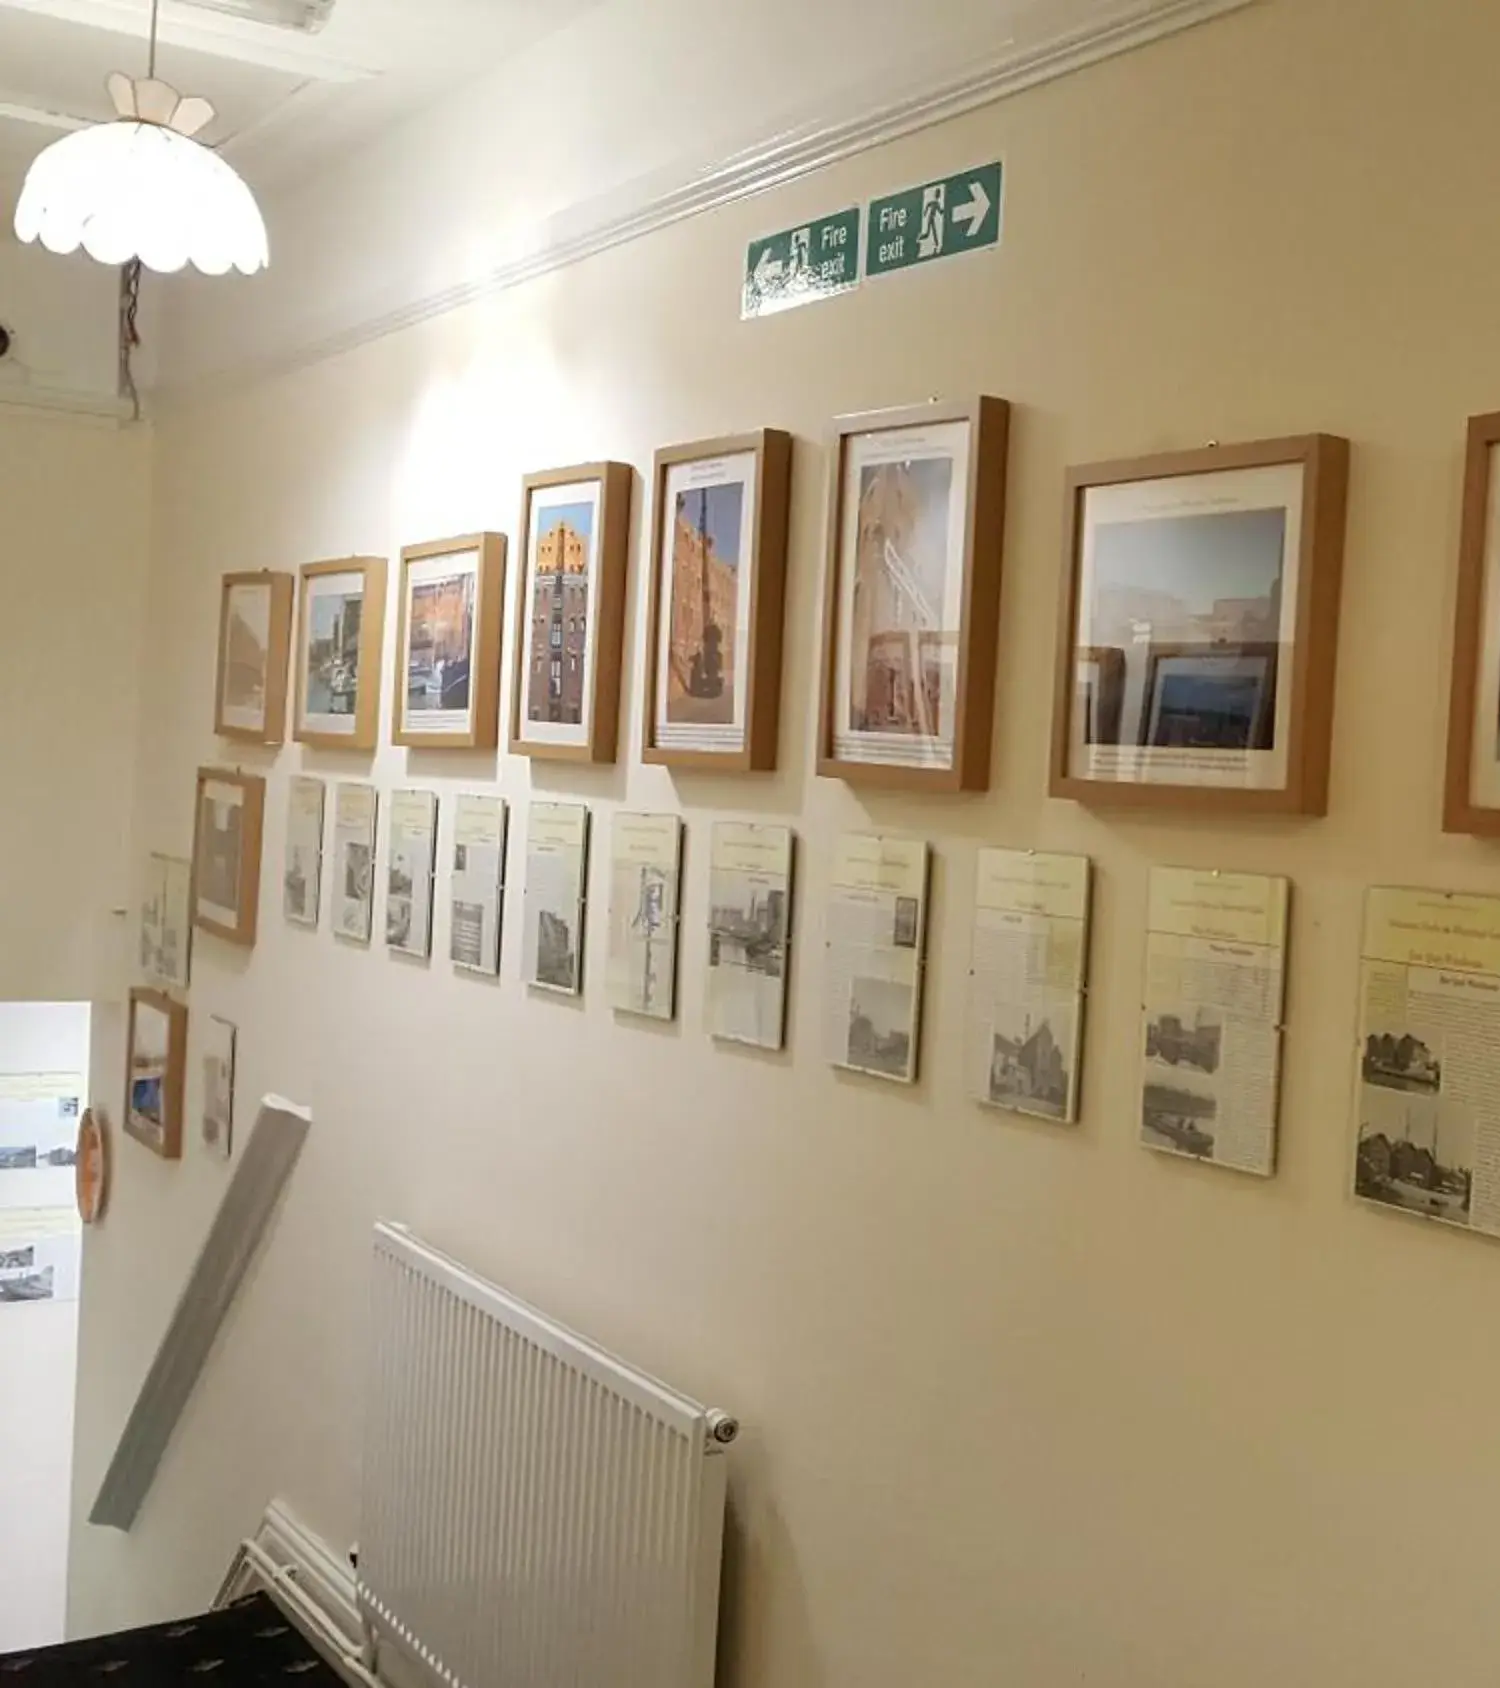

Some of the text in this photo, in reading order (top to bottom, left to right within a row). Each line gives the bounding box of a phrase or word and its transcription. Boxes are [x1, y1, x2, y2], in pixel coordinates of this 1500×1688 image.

[879, 207, 907, 232] Fire
[821, 226, 847, 249] Fire
[879, 237, 904, 263] exit
[820, 254, 845, 279] exit
